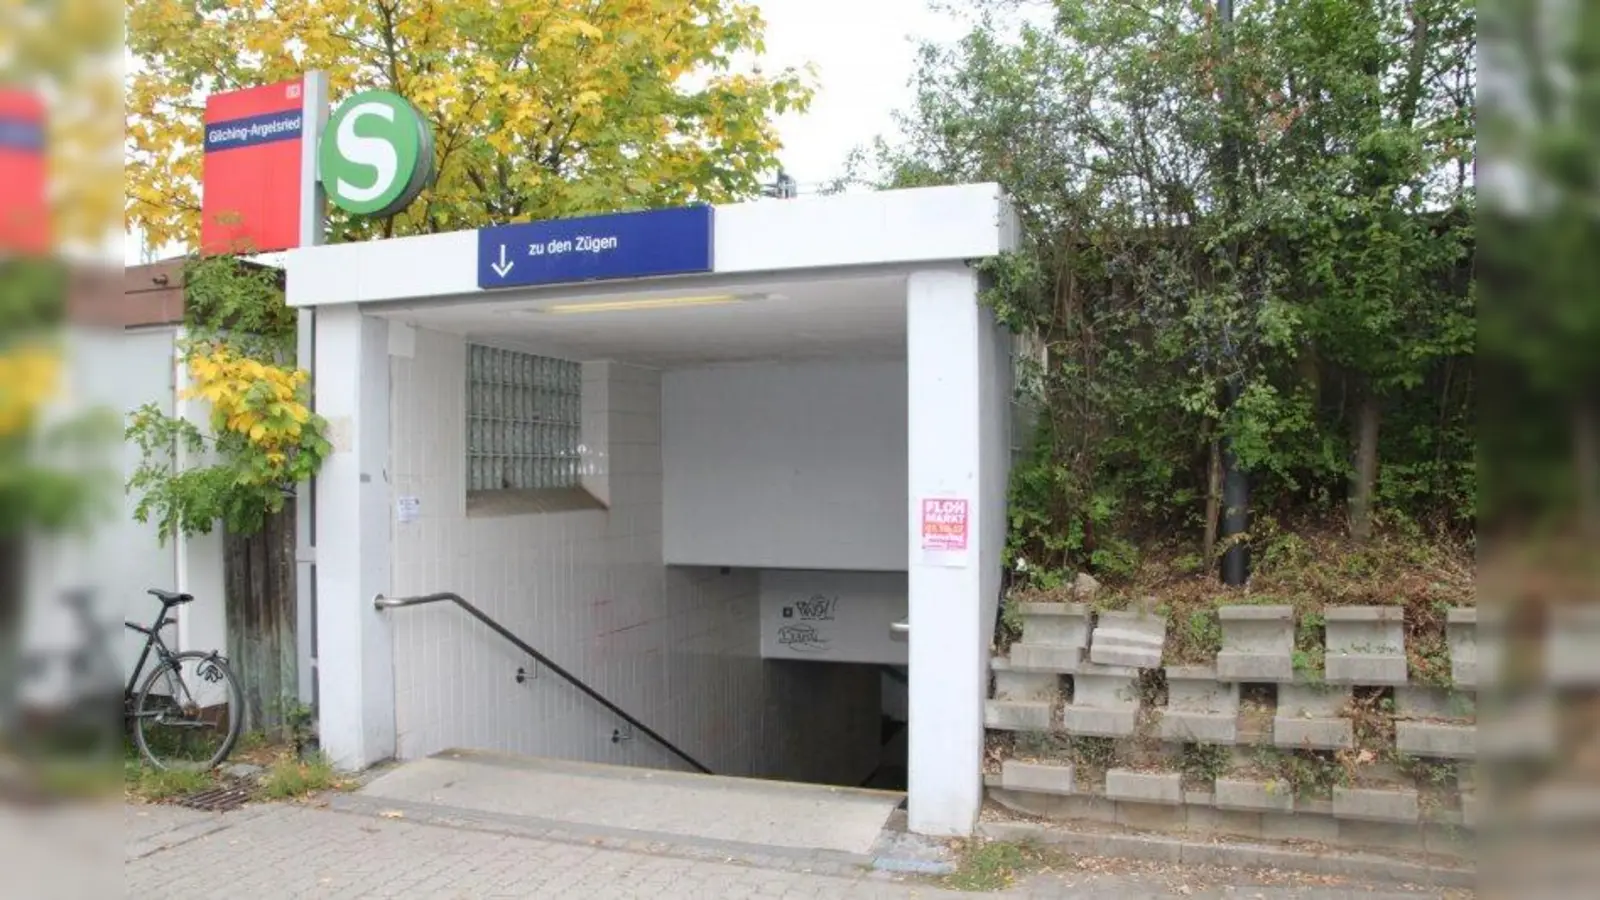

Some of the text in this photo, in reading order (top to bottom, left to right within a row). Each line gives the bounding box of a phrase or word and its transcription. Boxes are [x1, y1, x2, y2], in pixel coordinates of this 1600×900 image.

[208, 116, 301, 143] Gilching-Argelsried
[337, 102, 398, 202] S
[529, 236, 617, 255] zu den Zügen
